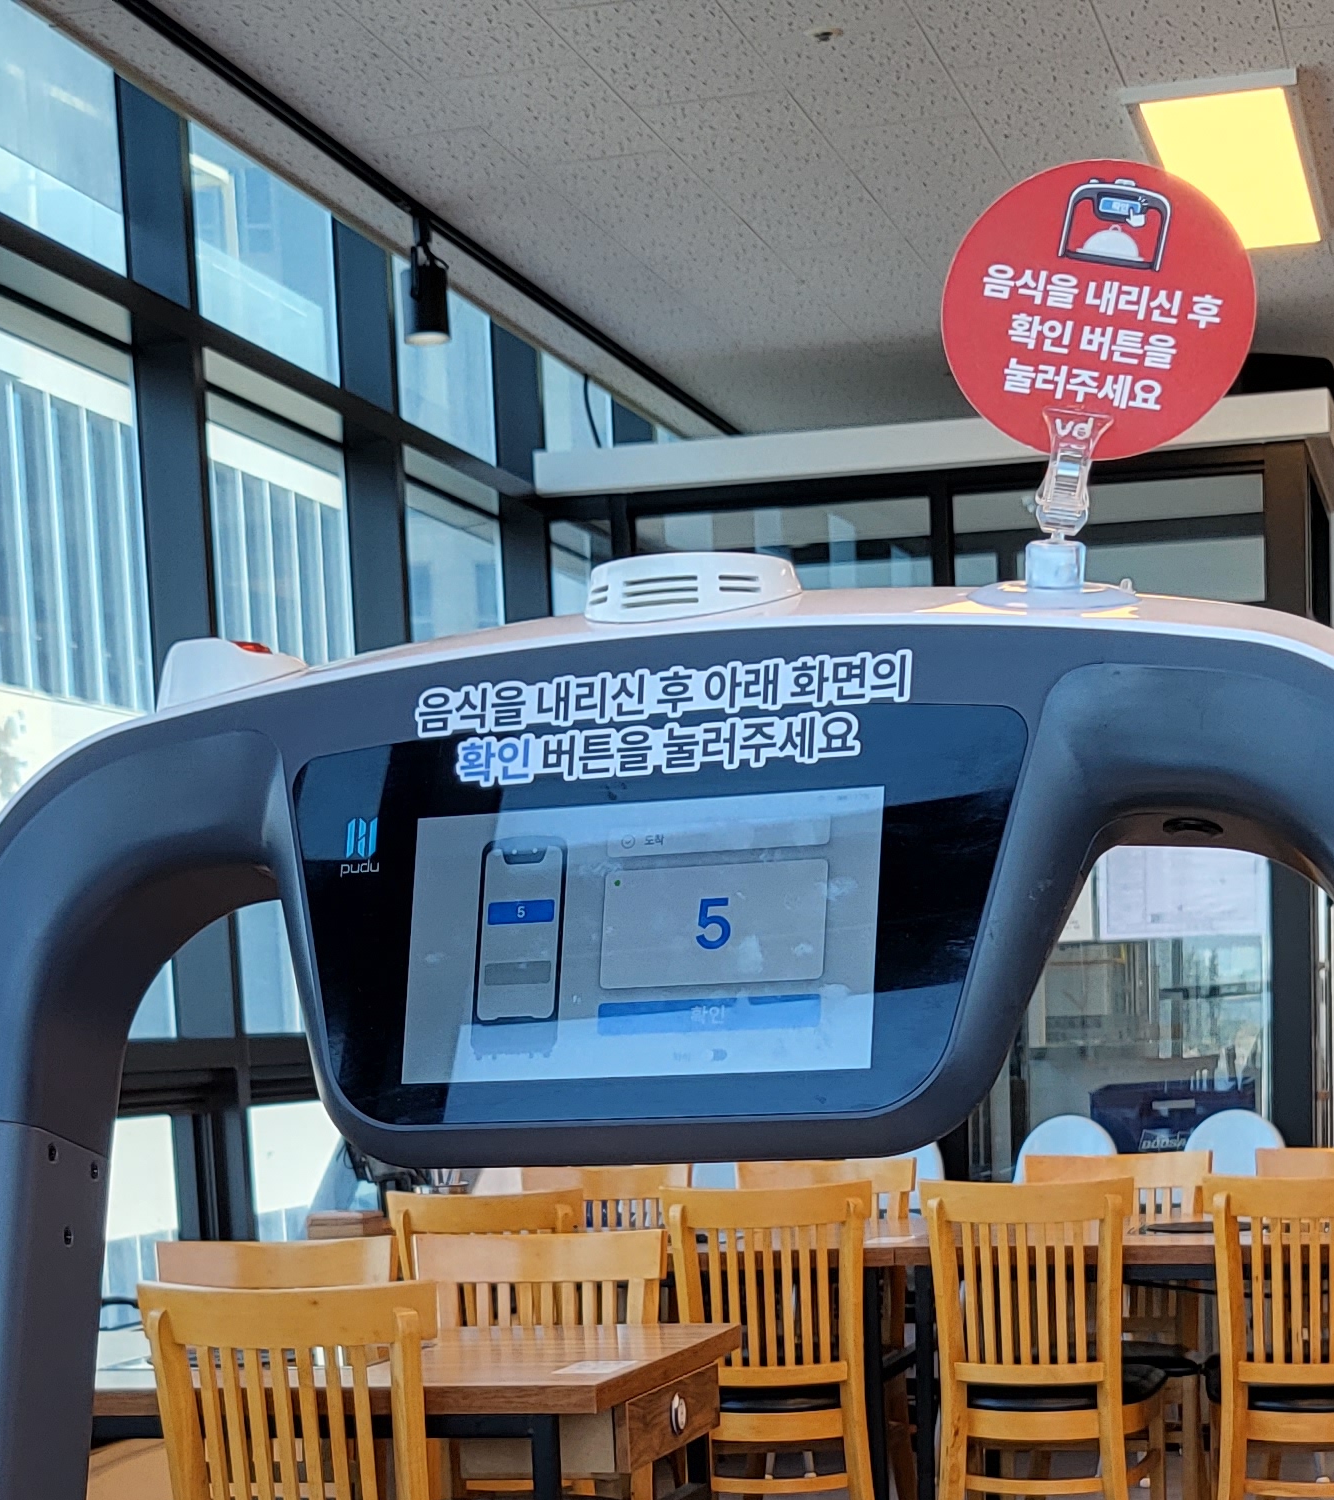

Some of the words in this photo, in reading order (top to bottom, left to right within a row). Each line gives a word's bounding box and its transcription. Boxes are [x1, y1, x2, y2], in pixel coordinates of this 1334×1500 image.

[983, 262, 1079, 309] 음식을
[1085, 281, 1182, 325] 내리신
[1187, 294, 1223, 330] 후
[1008, 312, 1074, 354] 확인
[1079, 324, 1177, 370] 버튼을
[1003, 358, 1162, 412] 눌러주세요
[418, 682, 527, 735] 음식을
[536, 667, 647, 725] 내리신
[656, 668, 694, 717] 후
[703, 659, 778, 711] 아래
[791, 651, 911, 703] 화면의
[459, 739, 533, 784] 확인
[542, 725, 653, 776] 버튼을
[662, 713, 859, 770] 눌러주세요
[340, 858, 380, 878] pudu
[516, 906, 526, 918] 5
[695, 897, 732, 950] 5
[691, 1005, 725, 1024] 확인
